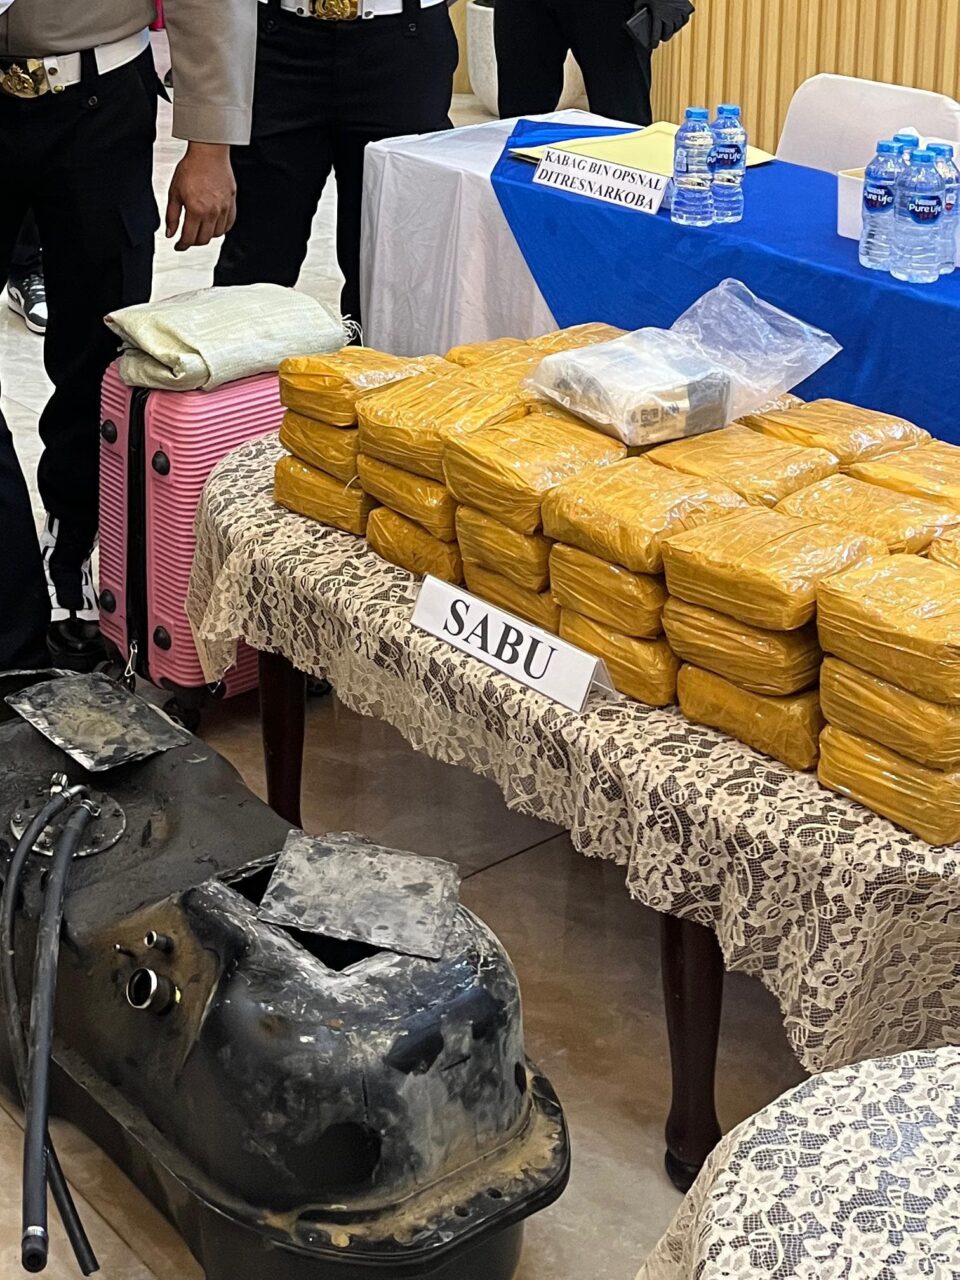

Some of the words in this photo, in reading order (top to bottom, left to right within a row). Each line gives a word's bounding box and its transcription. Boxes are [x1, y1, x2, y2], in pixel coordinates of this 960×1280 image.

[537, 168, 654, 210] DITRESNARKOBA
[544, 150, 588, 171] KABAG
[588, 161, 612, 176] BIN
[612, 168, 663, 191] OPSNAL
[909, 204, 930, 213] Pure
[442, 598, 559, 680] SABU
